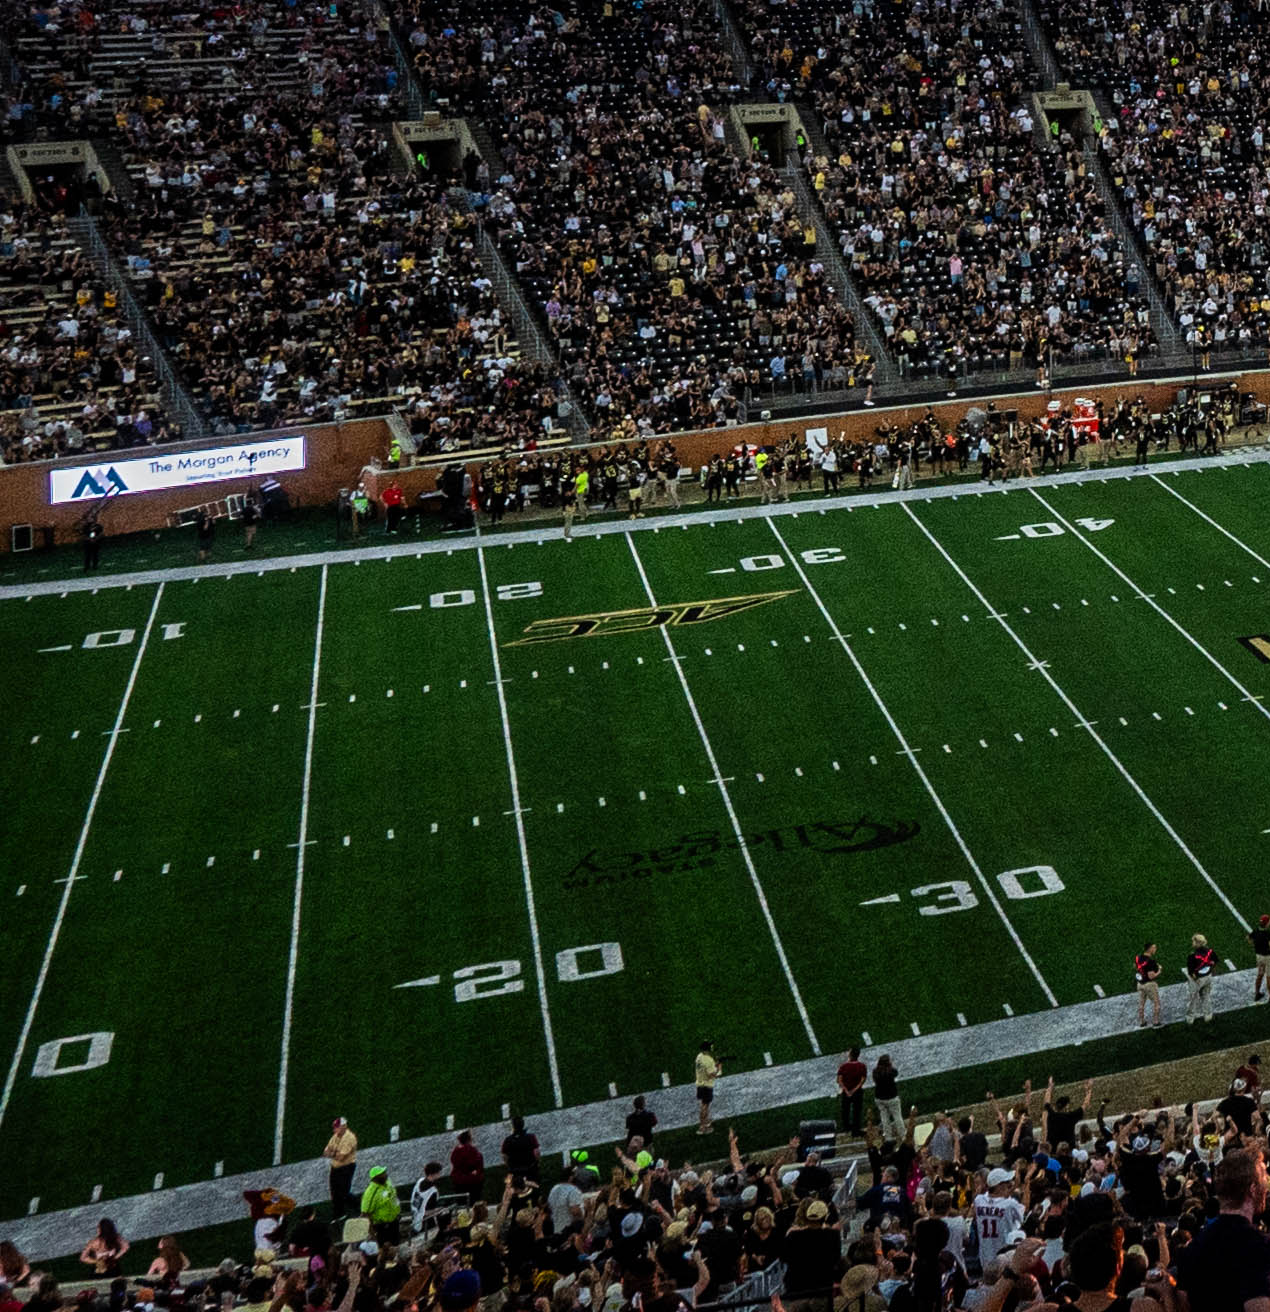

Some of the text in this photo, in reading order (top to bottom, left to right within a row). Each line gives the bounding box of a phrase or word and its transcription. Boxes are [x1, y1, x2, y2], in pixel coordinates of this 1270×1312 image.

[149, 461, 173, 474] The
[177, 453, 234, 472] Morgan
[238, 445, 291, 464] Agency
[1018, 514, 1117, 539] 40
[738, 546, 851, 574] 30
[428, 580, 546, 611] 20
[82, 620, 188, 651] 10
[910, 864, 1066, 916] 30
[450, 941, 625, 1002] 20
[981, 1218, 1000, 1239] 11
